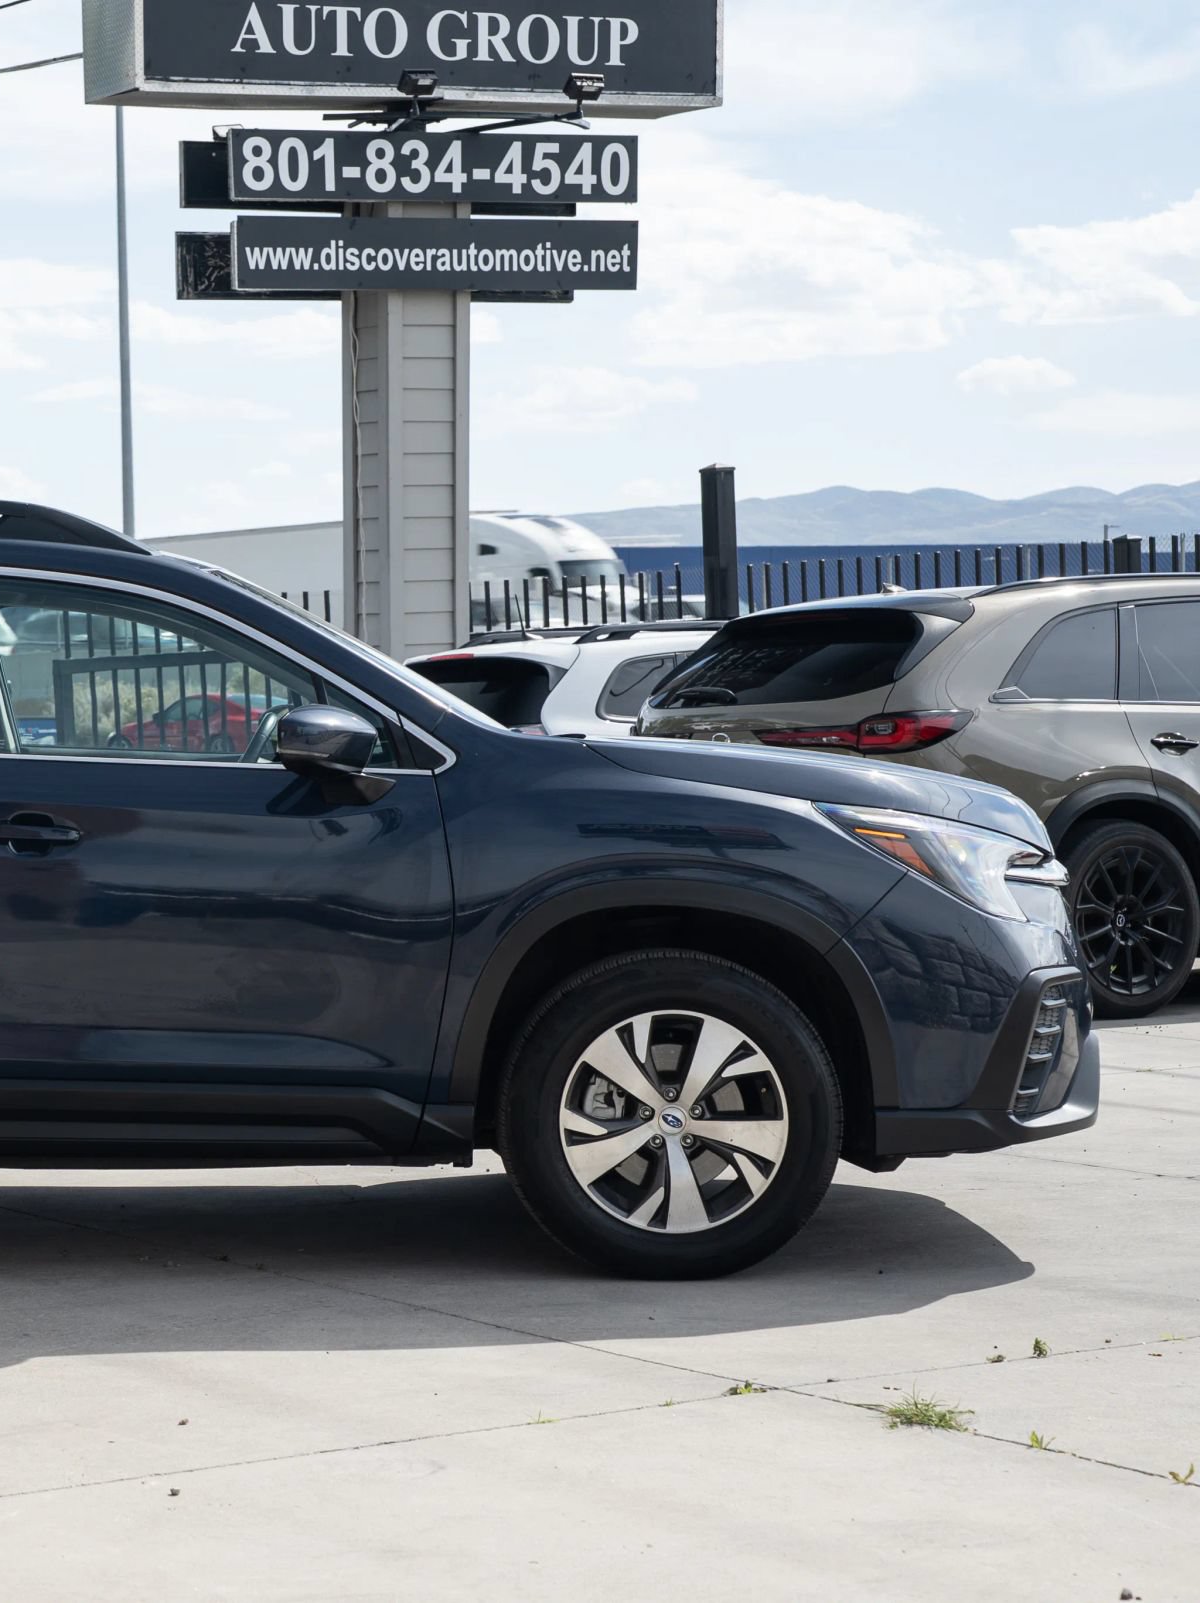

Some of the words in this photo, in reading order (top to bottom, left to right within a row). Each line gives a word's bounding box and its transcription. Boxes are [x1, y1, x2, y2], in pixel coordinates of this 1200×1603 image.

[230, 1, 409, 59] AUTO
[426, 9, 640, 66] GROUP
[241, 136, 631, 196] 801-834-4540
[244, 239, 632, 273] www.discoverautomotive.net
